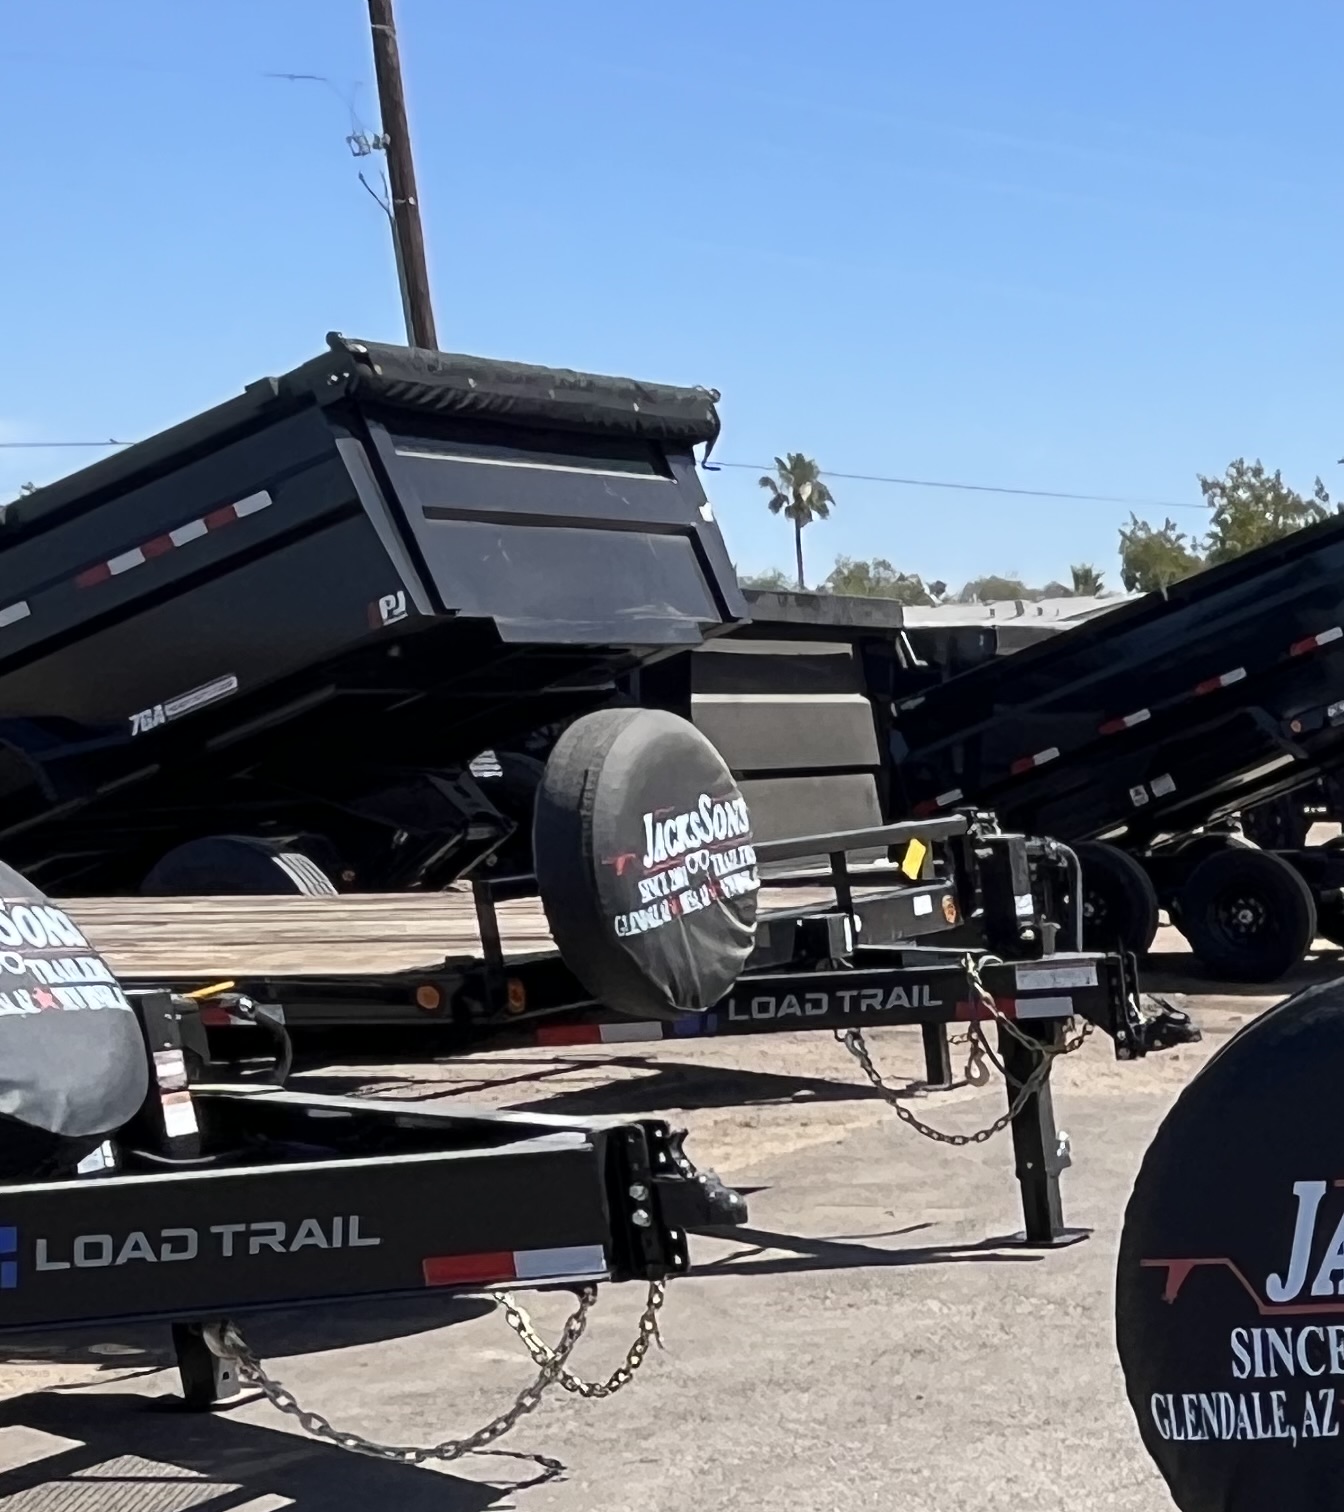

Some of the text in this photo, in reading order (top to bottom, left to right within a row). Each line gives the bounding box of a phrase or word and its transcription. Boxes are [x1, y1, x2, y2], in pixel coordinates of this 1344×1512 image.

[727, 984, 943, 1022] LOAD TRAIL
[35, 1214, 382, 1271] LOAD TRAIL
[1150, 1391, 1297, 1448] GLENDALE,
[1302, 1388, 1340, 1438] AZ
